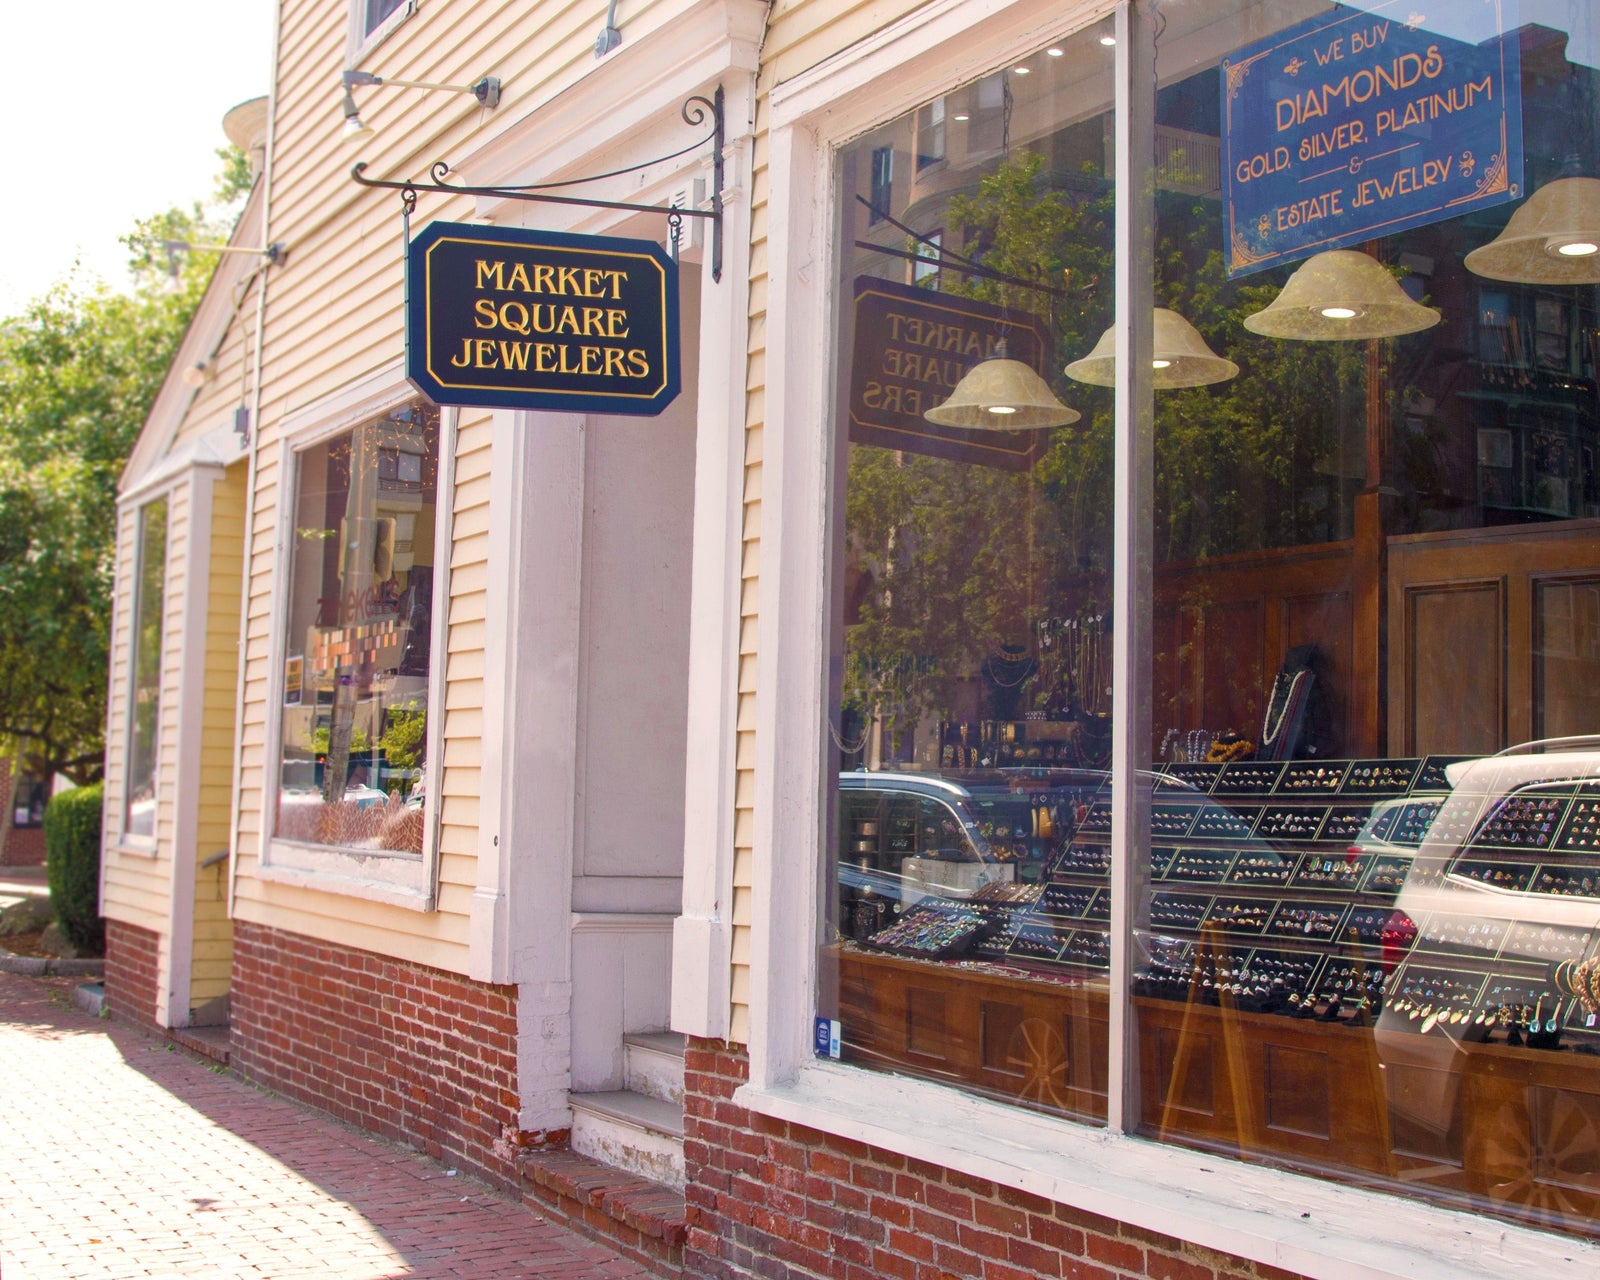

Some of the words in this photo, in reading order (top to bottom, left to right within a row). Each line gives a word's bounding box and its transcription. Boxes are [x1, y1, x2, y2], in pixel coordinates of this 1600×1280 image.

[1313, 39, 1344, 67] WE
[1351, 21, 1389, 54] BUY
[1276, 45, 1443, 132] DIAMONDS
[1236, 147, 1291, 183] GOLD,
[1299, 120, 1368, 162] SILVER,
[1376, 76, 1492, 136] PLATINUM
[1349, 156, 1364, 174] &
[1277, 189, 1343, 231] ESTATE
[1352, 155, 1452, 209] JEWELRY
[475, 259, 629, 300] MARKET
[474, 299, 630, 339] SQUARE
[450, 338, 650, 379] JEWELERS
